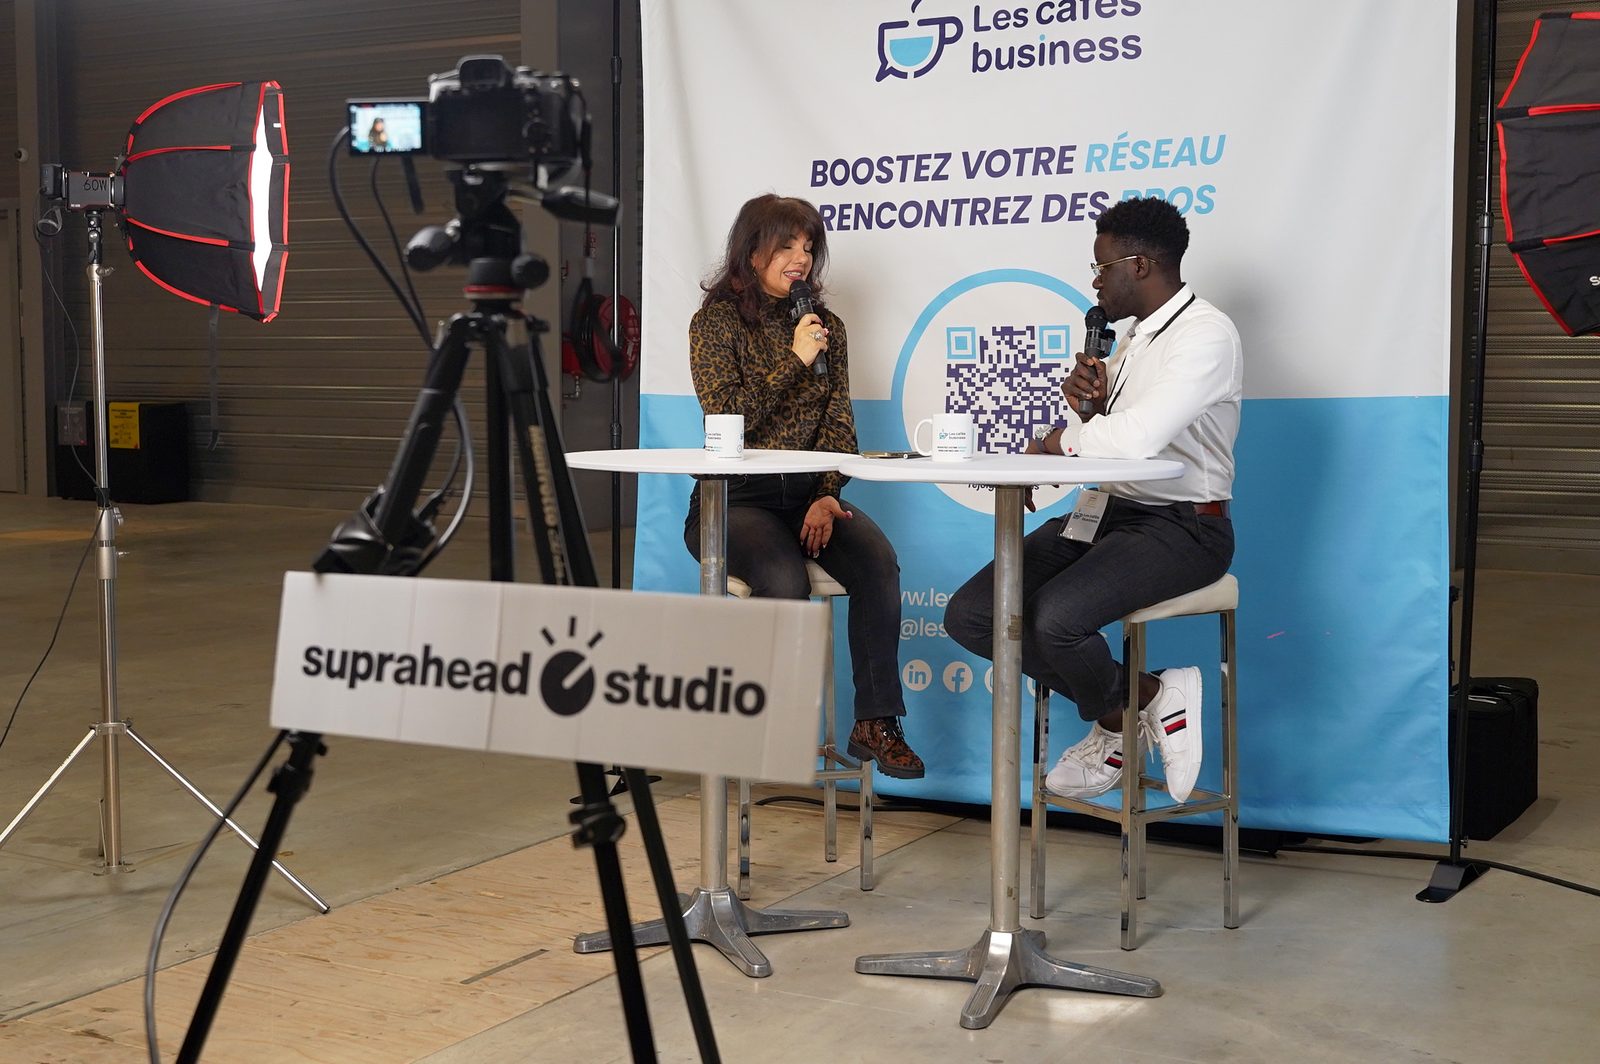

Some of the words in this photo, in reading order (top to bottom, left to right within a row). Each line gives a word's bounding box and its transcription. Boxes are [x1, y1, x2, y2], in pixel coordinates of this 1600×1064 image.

[973, 5, 1029, 32] Les
[972, 34, 1142, 73] business
[810, 152, 952, 187] BOOSTEZ
[962, 146, 1077, 179] VOTRE
[1085, 131, 1226, 172] RÉSEAU
[84, 179, 107, 191] 60W
[819, 195, 1032, 231] RENCONTREZ
[1041, 191, 1109, 223] DES
[303, 644, 531, 695] suprahead
[604, 664, 766, 717] studio
